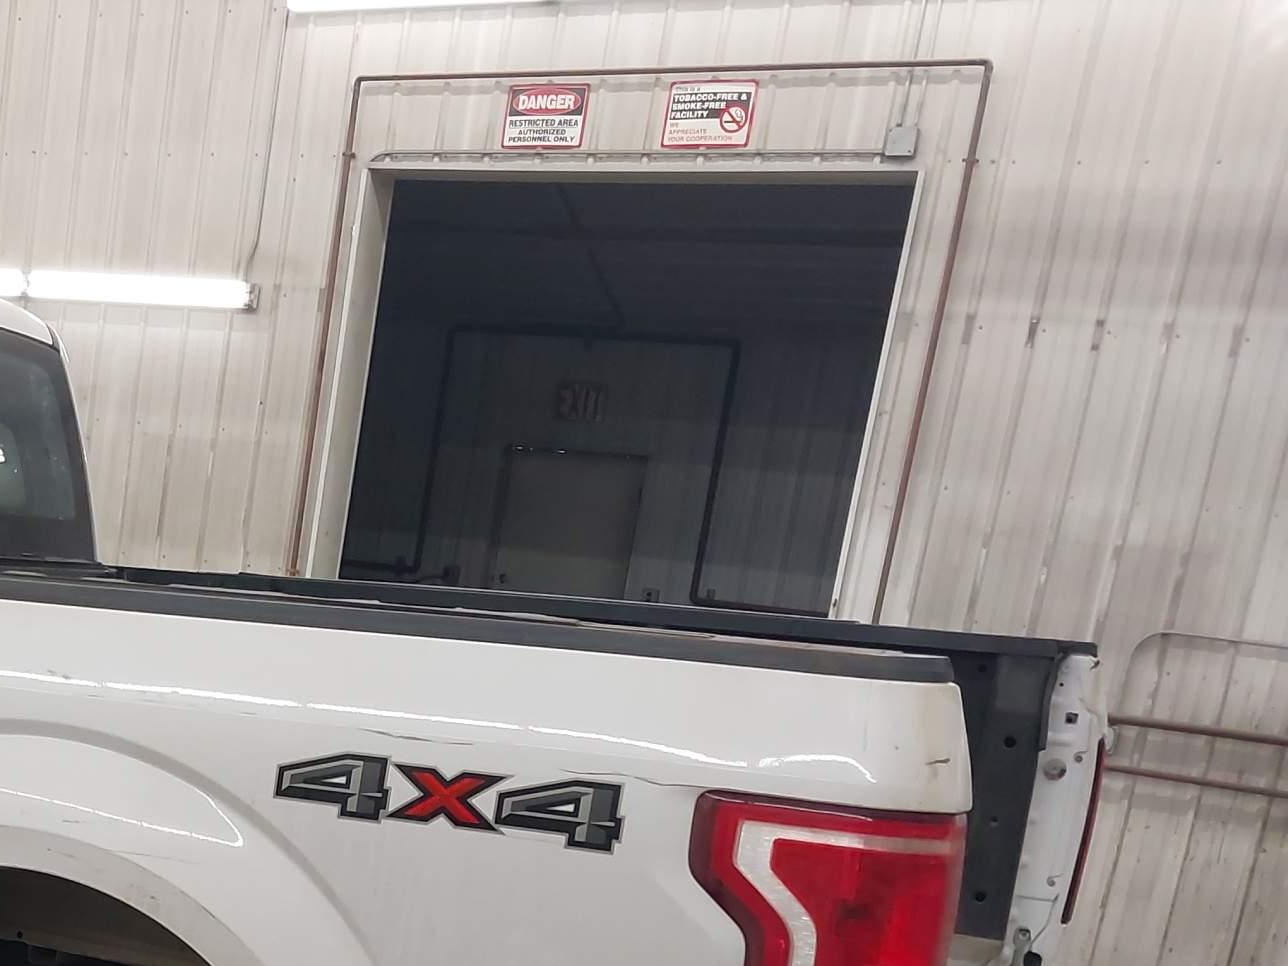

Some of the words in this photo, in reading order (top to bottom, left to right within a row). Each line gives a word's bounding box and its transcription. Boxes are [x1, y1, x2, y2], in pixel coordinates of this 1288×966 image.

[518, 94, 575, 110] DANGER
[674, 93, 739, 102] TOBACCO-FREE
[672, 101, 727, 111] SMOKE-FREE
[671, 110, 709, 119] FACILITY
[509, 119, 556, 128] RESTRICTED
[558, 118, 579, 127] AREA
[556, 385, 603, 421] EXIT
